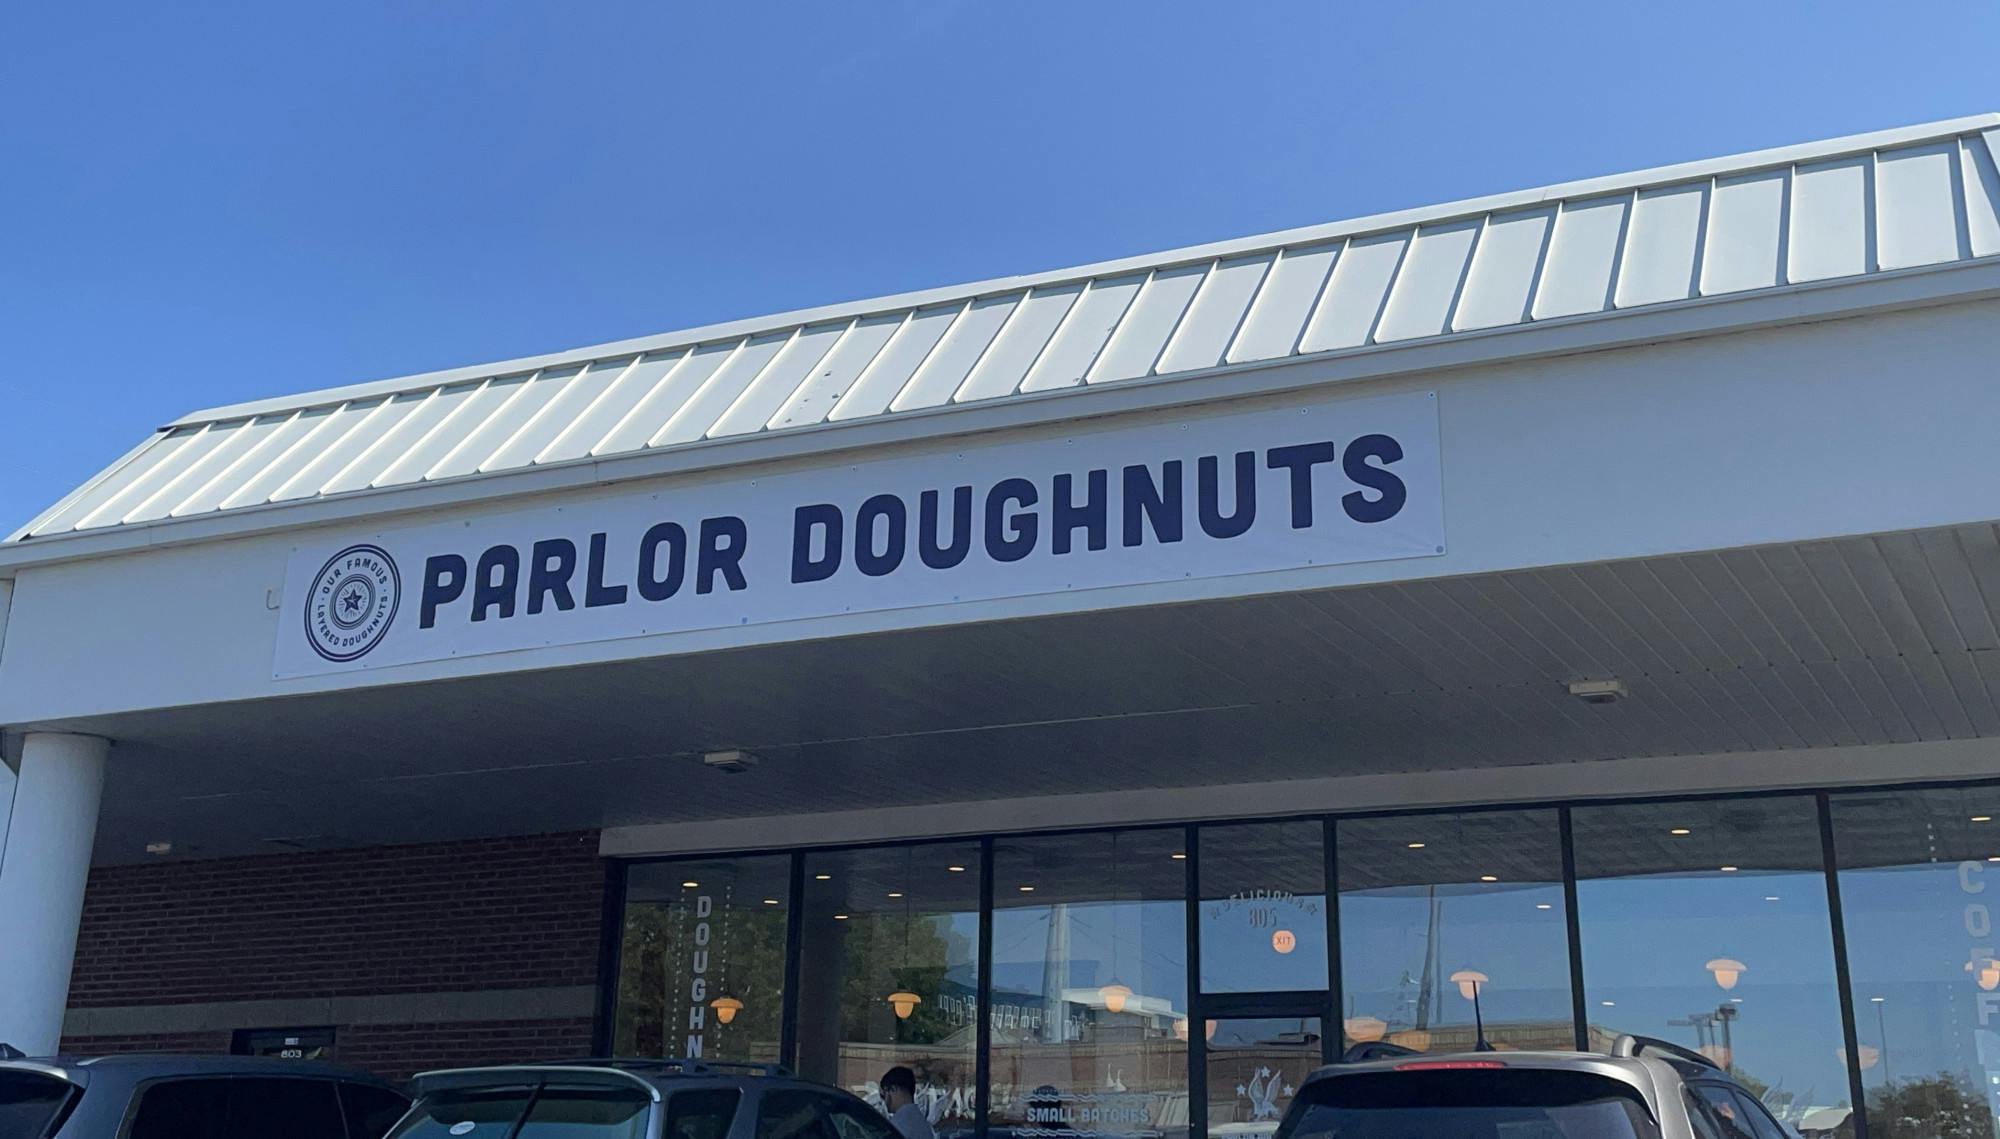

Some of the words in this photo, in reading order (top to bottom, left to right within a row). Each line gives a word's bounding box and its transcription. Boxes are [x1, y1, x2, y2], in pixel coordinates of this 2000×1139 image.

[420, 517, 748, 630] PARLOR
[791, 434, 1407, 584] DOUGHNUTS
[322, 568, 342, 594] OUR
[346, 558, 387, 585] FAMOUS
[317, 604, 340, 646] LAYERED
[342, 596, 388, 647] DOUGHNUTS
[281, 1049, 302, 1058] 803
[1027, 1107, 1076, 1122] SMALL
[1081, 1106, 1149, 1122] BATCHES
